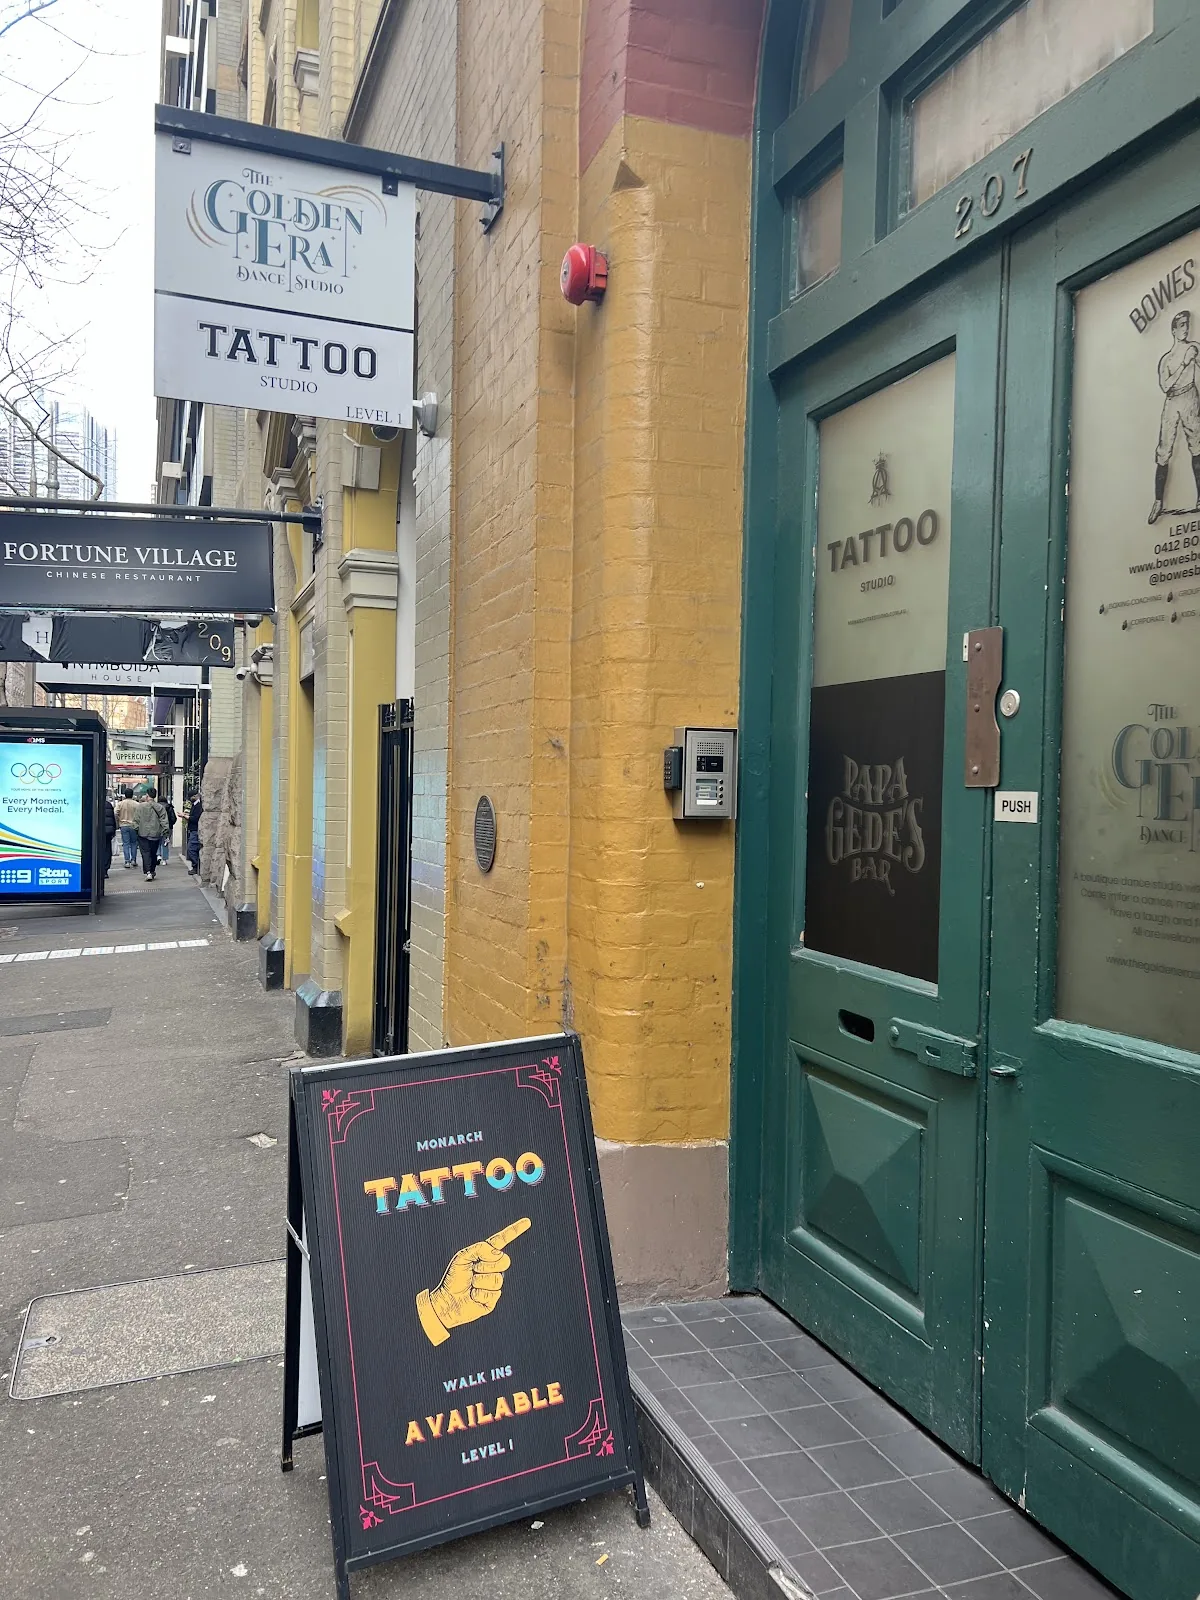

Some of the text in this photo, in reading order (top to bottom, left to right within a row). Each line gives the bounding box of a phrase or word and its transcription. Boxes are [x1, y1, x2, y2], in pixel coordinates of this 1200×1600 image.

[242, 168, 273, 186] THE
[955, 148, 1033, 239] 207
[204, 180, 363, 277] GOLDEN
[251, 217, 333, 292] ERA
[236, 266, 344, 295] DANCE STUDIO
[1129, 259, 1195, 334] BOWES
[197, 320, 378, 382] TATTOO
[260, 375, 318, 393] STUDIO
[346, 405, 403, 424] LEVEL 1
[827, 508, 938, 572] TATTOO
[1154, 540, 1180, 554] 0412
[4, 542, 238, 567] FORTUNE VILLAGE
[46, 571, 201, 582] CHINESE RESTAURANT
[860, 575, 894, 592] STUDIO
[35, 631, 49, 643] H
[198, 623, 231, 661] 209
[91, 674, 142, 682] HOUSE
[1148, 703, 1178, 721] THE
[116, 752, 152, 760] UPPERCUTS
[843, 754, 909, 805] PAPA
[1112, 724, 1200, 817] GOL
[2, 797, 69, 806] Every Moment,
[7, 806, 33, 814] Every
[1002, 800, 1031, 812] PUSH
[825, 797, 925, 873] GEDE'S
[1140, 825, 1187, 845] DANCE
[851, 857, 895, 896] BAR
[1121, 876, 1151, 888] dance
[416, 1131, 483, 1152] MONARCH
[363, 1151, 546, 1216] TATTOO
[443, 1365, 513, 1393] WALK INS
[404, 1381, 564, 1447] AVAILABLE
[461, 1442, 506, 1464] LEVEL
